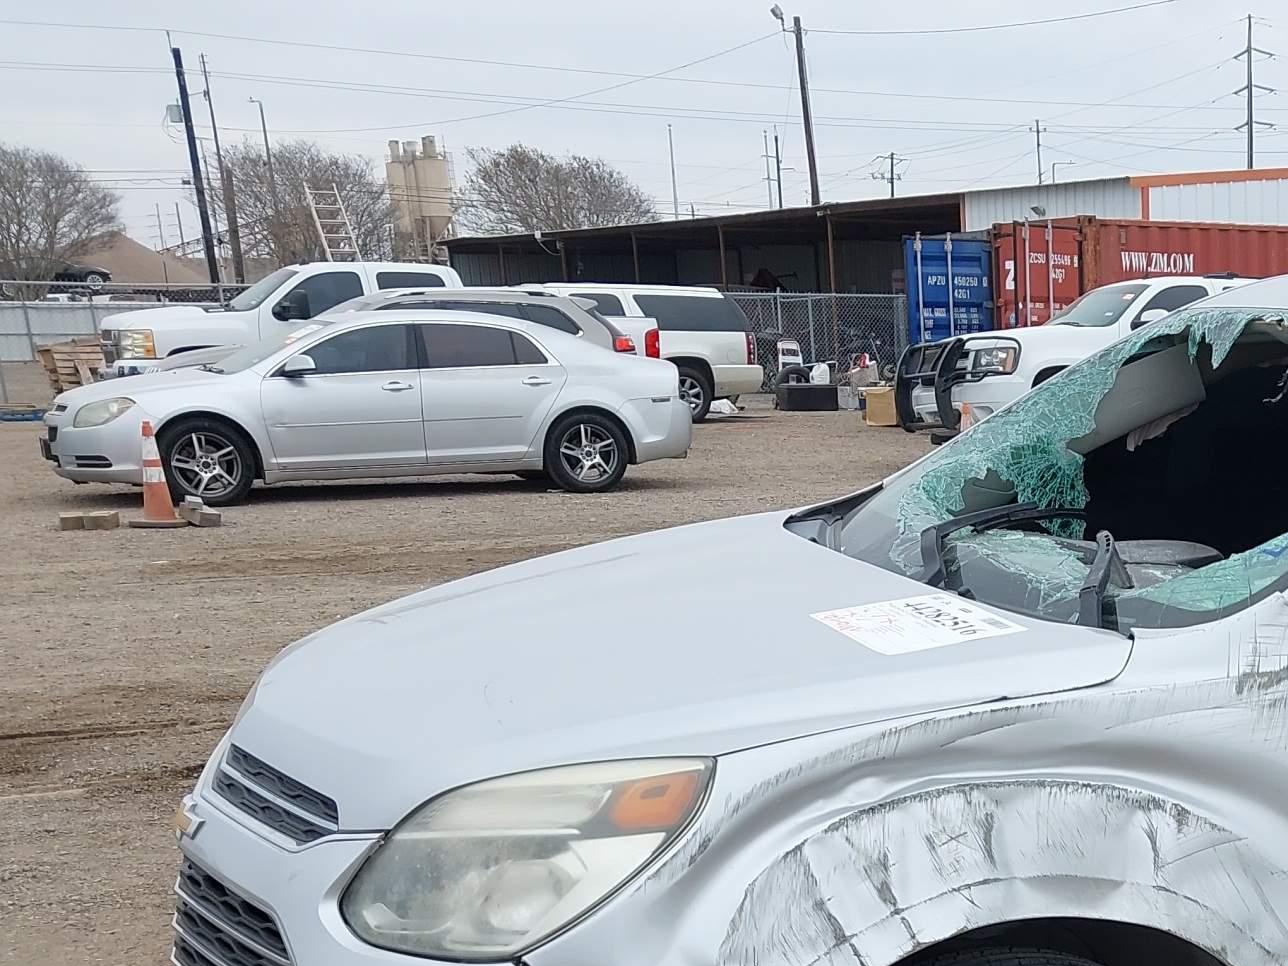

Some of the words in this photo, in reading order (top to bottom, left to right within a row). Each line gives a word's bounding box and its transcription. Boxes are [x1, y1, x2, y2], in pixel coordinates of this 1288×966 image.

[1120, 251, 1195, 273] WWW.ZIM.COM
[927, 275, 946, 286] APZU
[953, 276, 978, 287] 450250
[953, 289, 970, 299] 42G1
